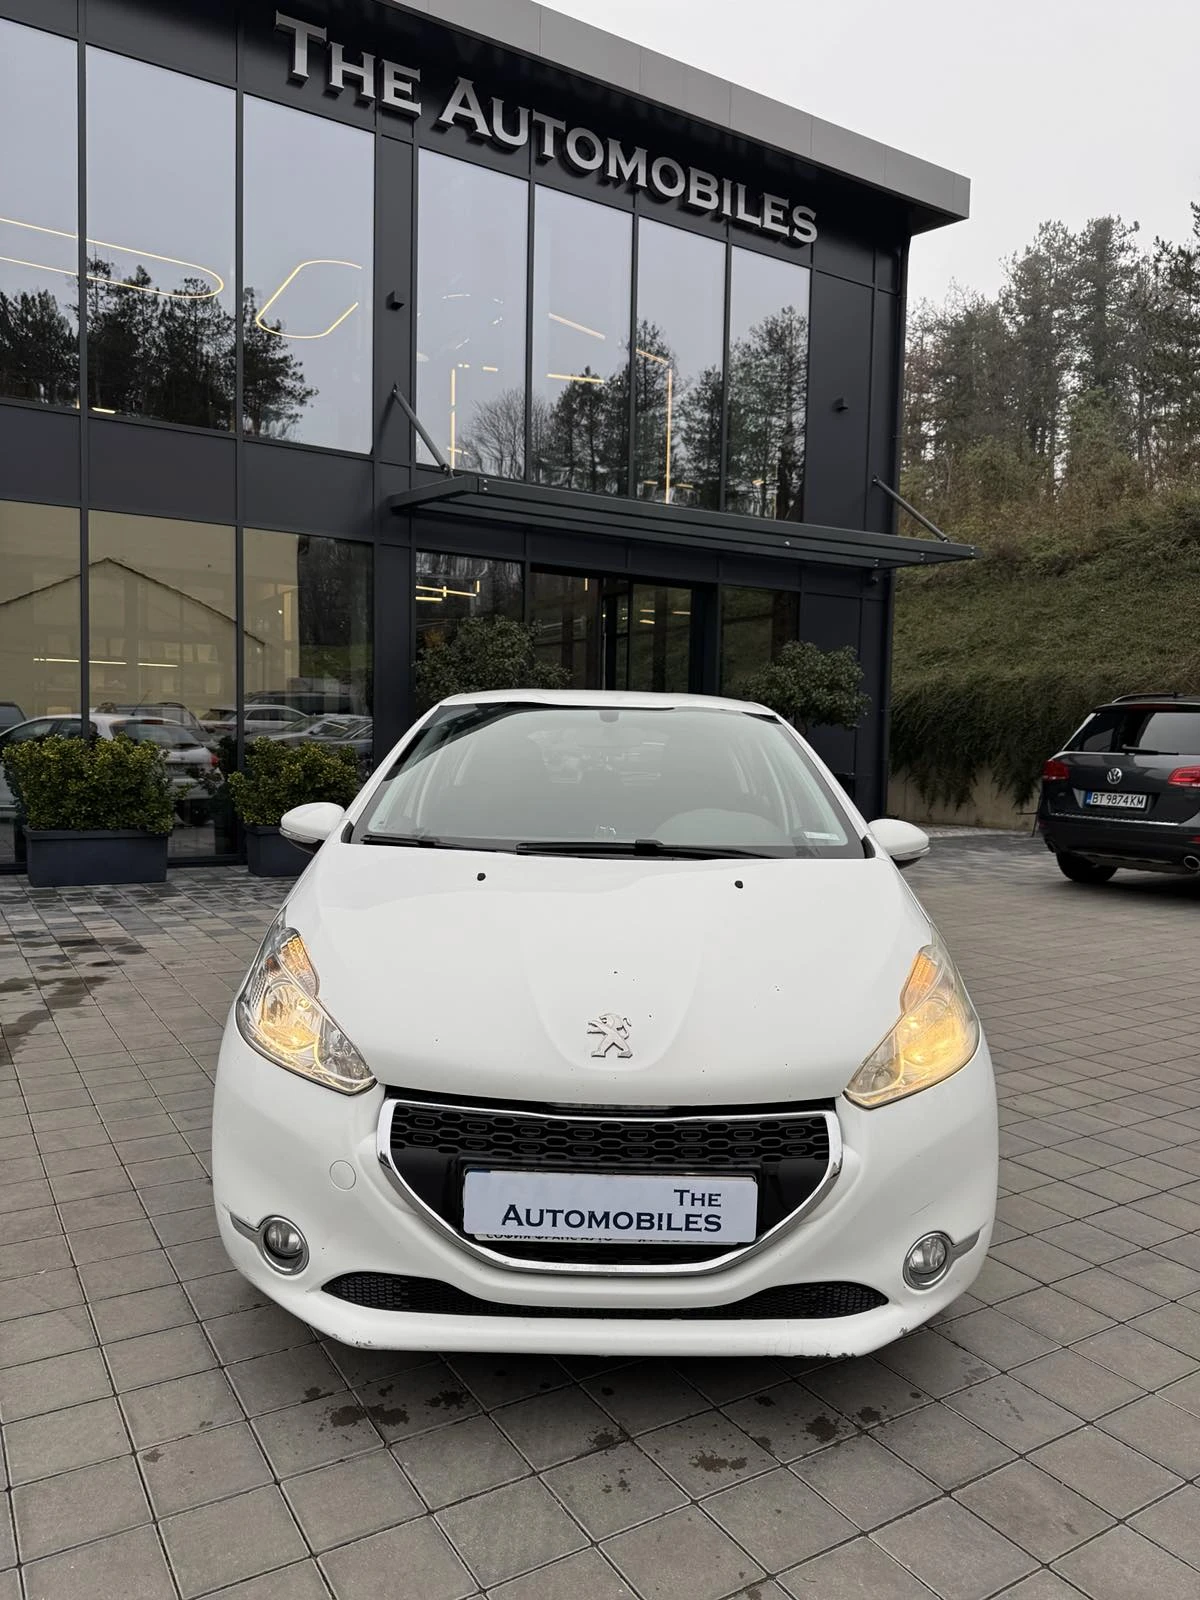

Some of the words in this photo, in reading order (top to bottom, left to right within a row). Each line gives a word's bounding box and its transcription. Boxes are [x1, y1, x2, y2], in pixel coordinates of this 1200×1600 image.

[275, 9, 422, 116] THE
[438, 76, 818, 243] AUTOMOBILES
[673, 1188, 722, 1208] THE
[501, 1204, 722, 1233] AUTOMOBILES
